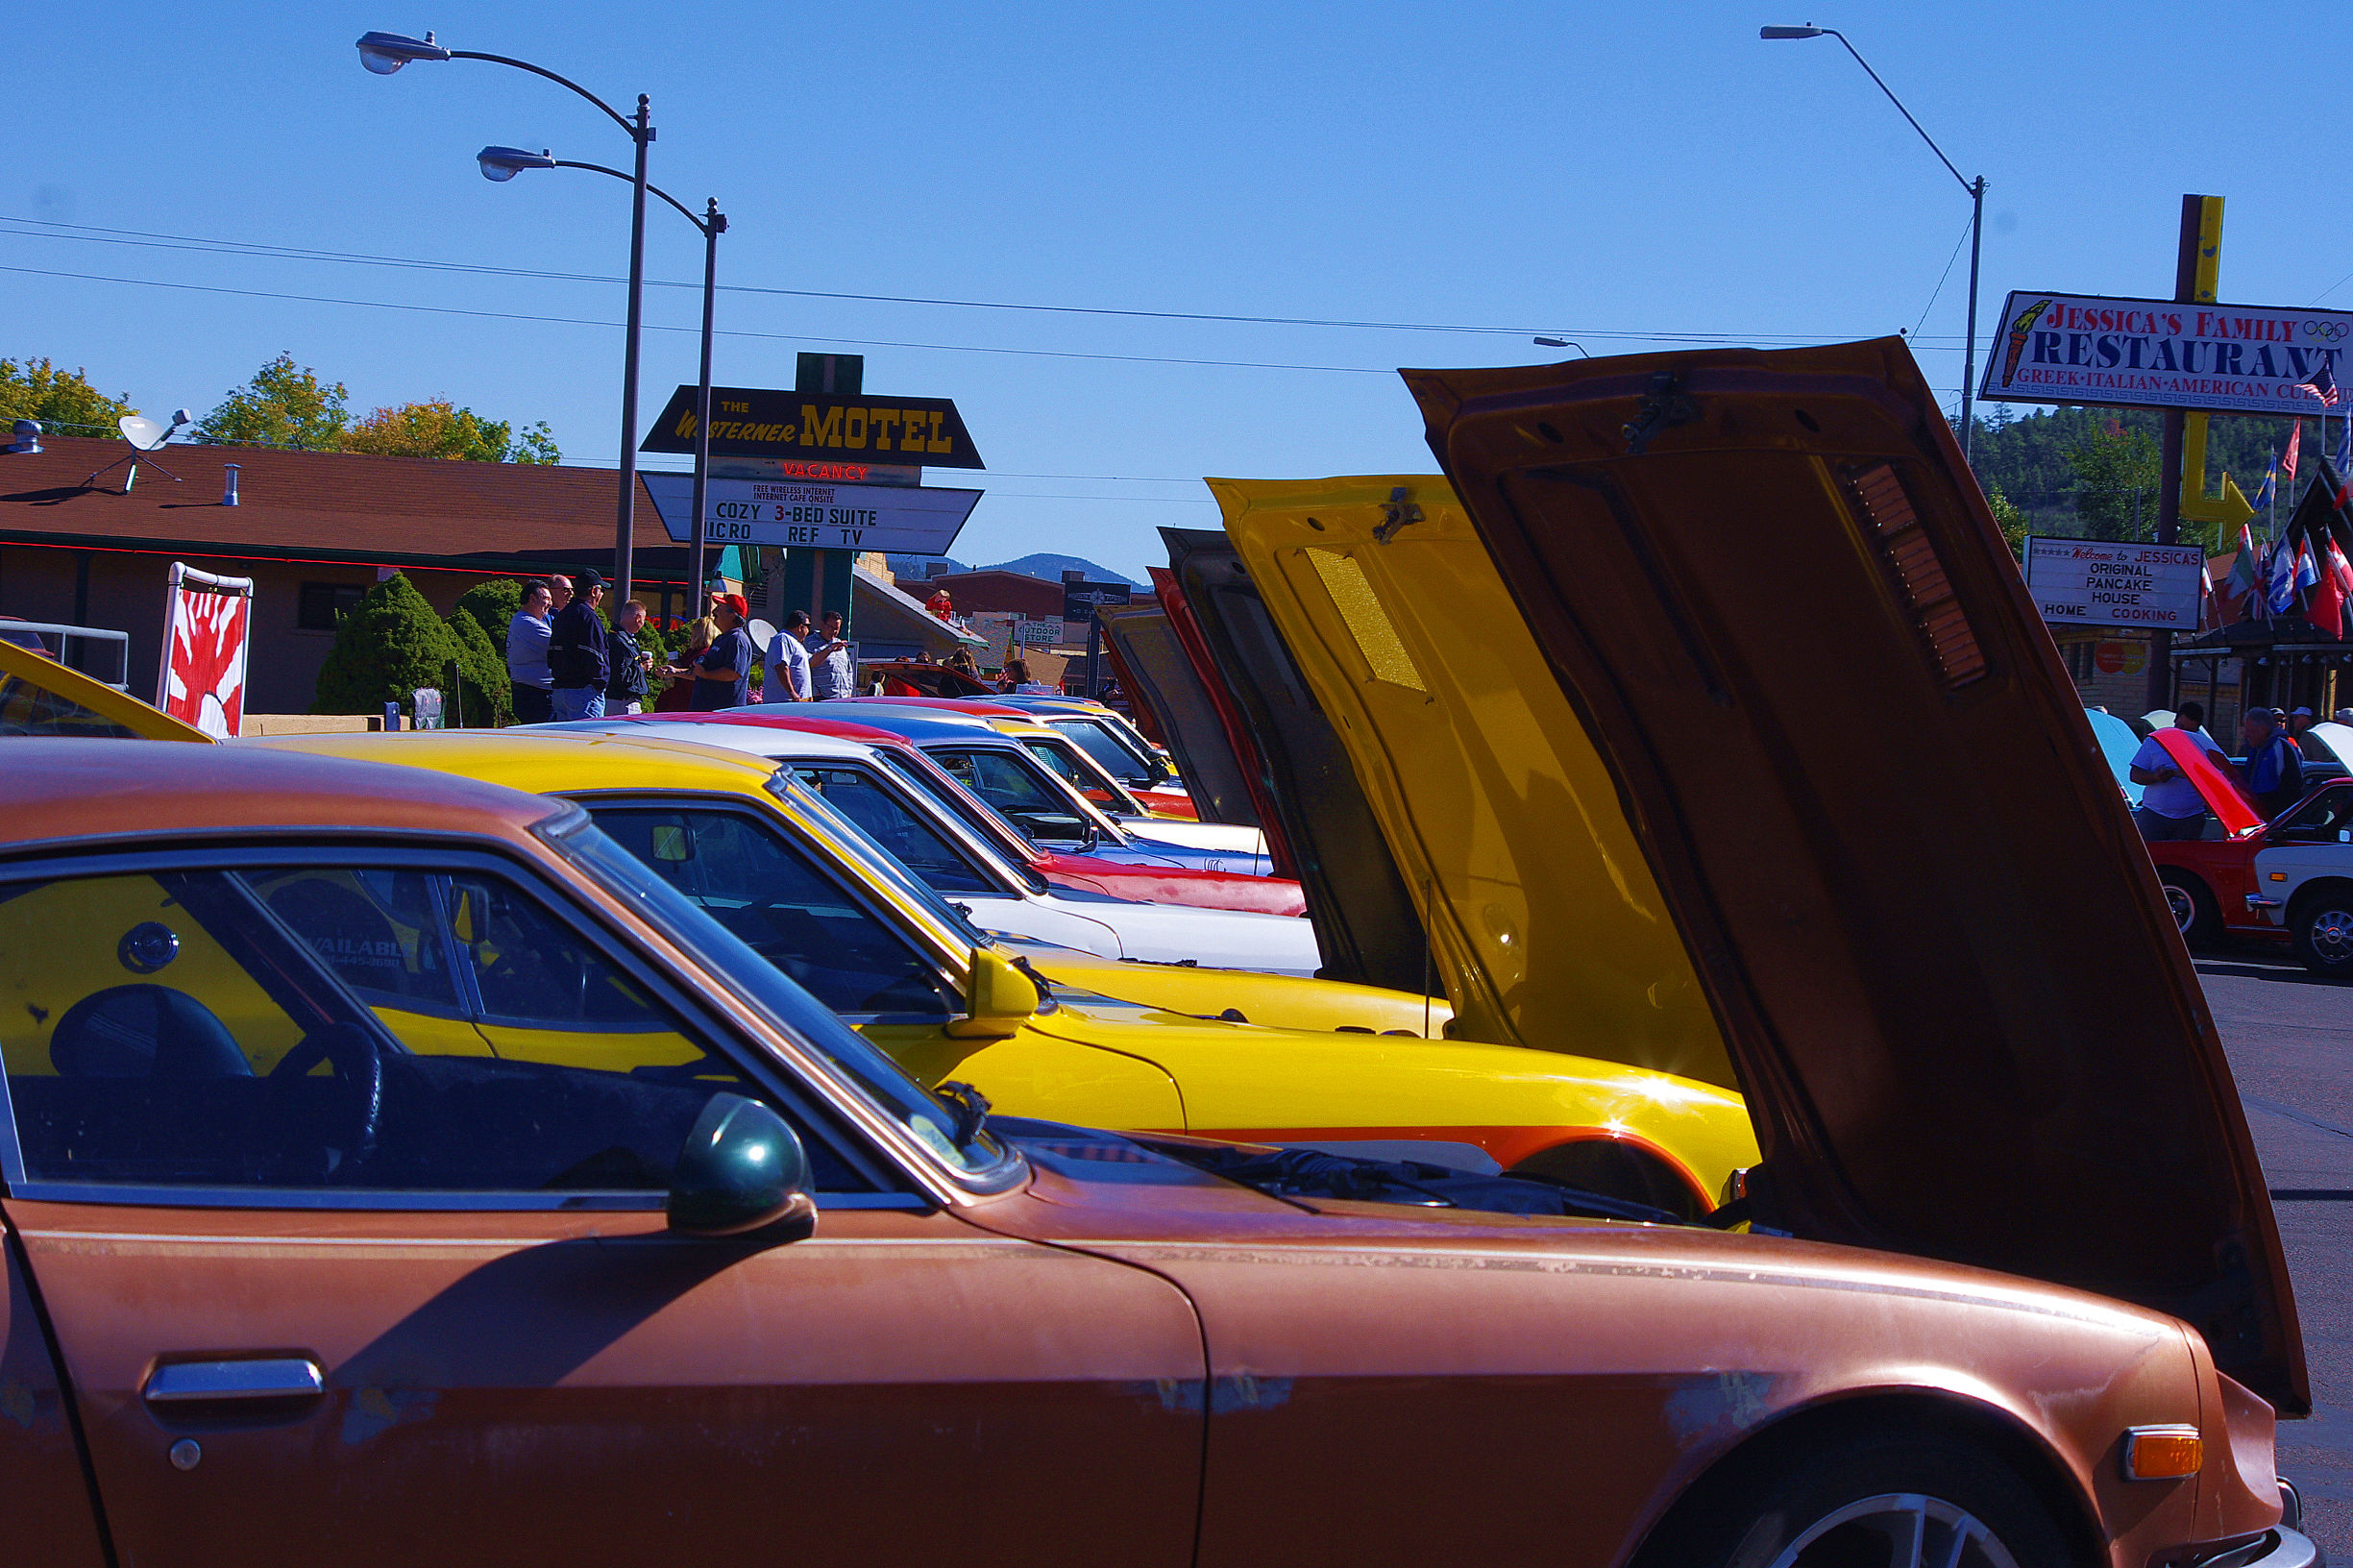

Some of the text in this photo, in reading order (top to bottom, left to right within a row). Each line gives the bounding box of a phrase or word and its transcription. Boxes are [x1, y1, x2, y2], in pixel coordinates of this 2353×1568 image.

[2047, 304, 2298, 342] JESSICA'S FAMILY
[2030, 331, 2343, 380] RESTAURANT
[722, 401, 749, 413] THE
[675, 404, 952, 453] WSTERNER MOTEL
[783, 462, 868, 479] VACANCY
[753, 484, 835, 496] FREE WIRELESS INTERNET
[753, 492, 835, 503] INTERNET CAFE ONSITE
[716, 502, 876, 527] COZY 3-BED SUITE
[704, 521, 863, 546] ICRO REF TV
[2071, 546, 2199, 565] Welcome to JESSICA'S
[2090, 562, 2153, 576] ORIGINAL
[2086, 576, 2153, 591] PANCAKE
[2092, 591, 2141, 605] HOUSE
[2045, 603, 2176, 622] HOME COOKING
